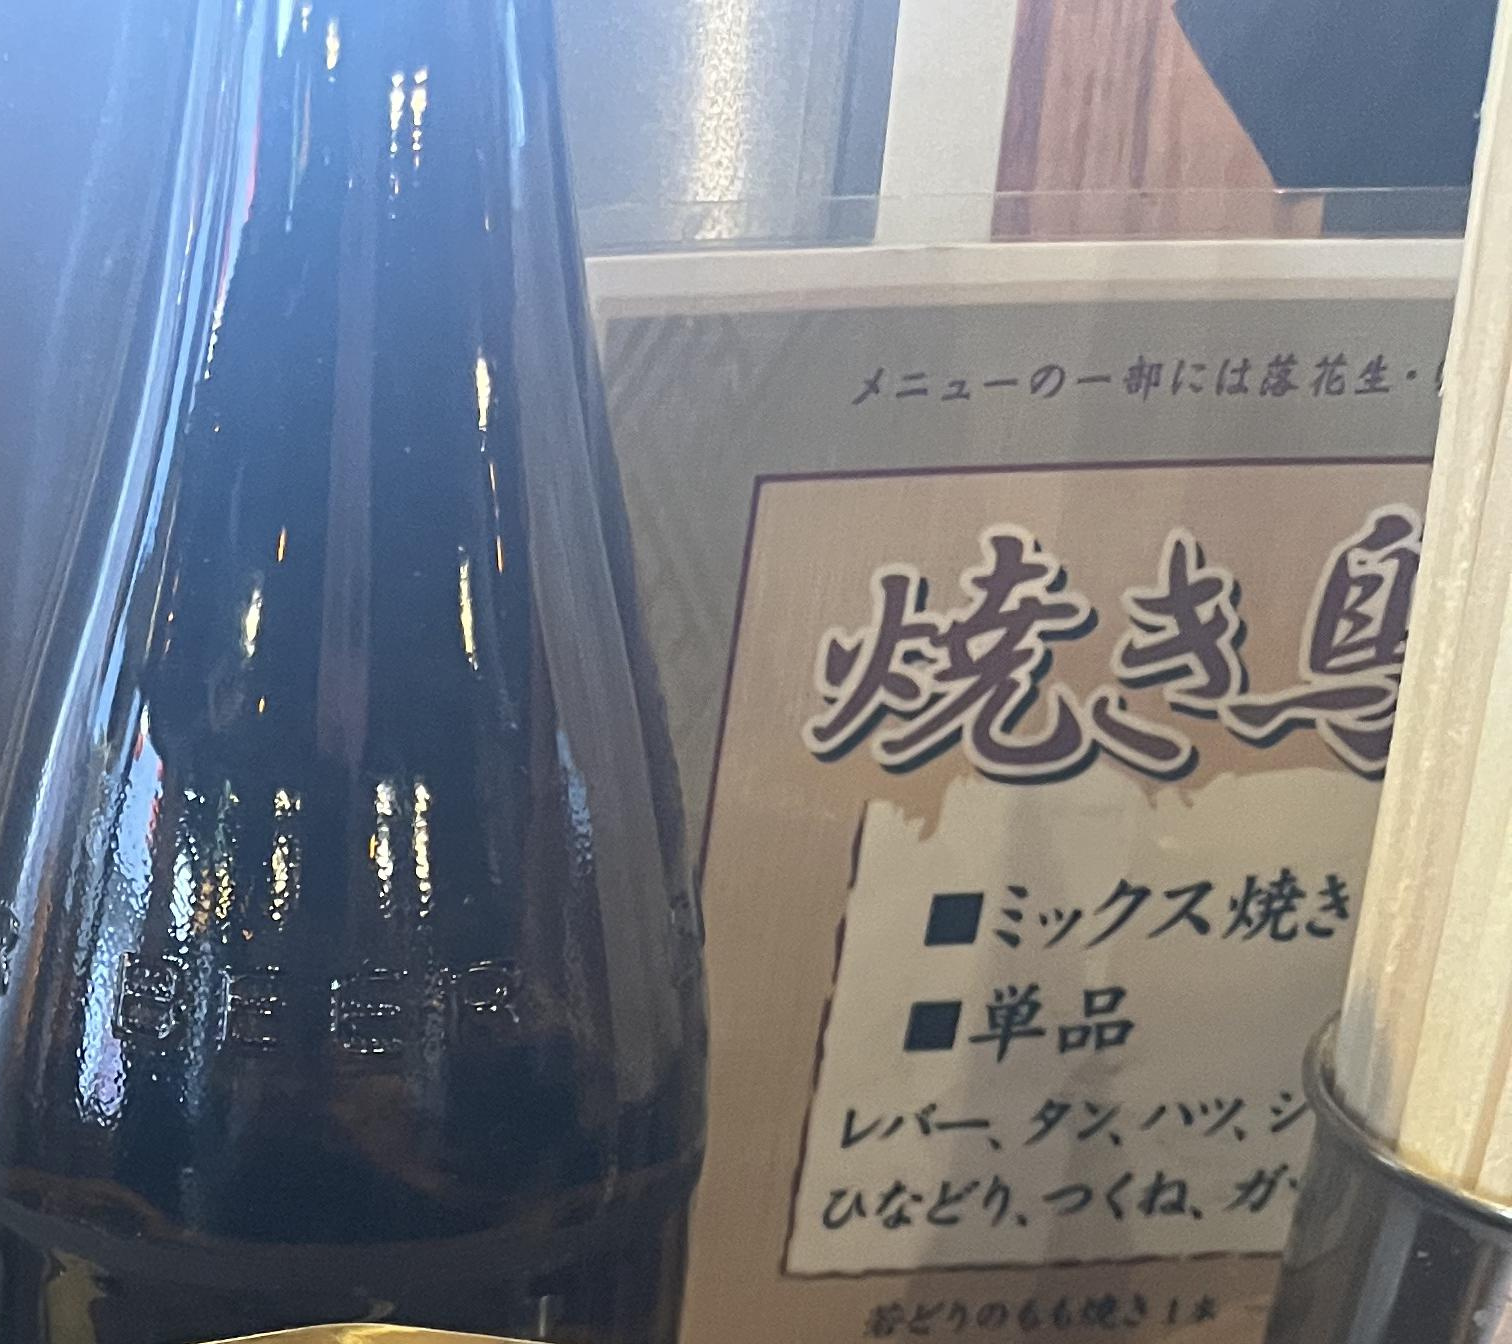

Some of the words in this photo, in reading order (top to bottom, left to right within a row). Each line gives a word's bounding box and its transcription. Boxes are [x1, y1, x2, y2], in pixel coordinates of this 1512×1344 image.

[853, 354, 1445, 404] メニューの一部には落花生・
[968, 983, 1135, 1063] 単品
